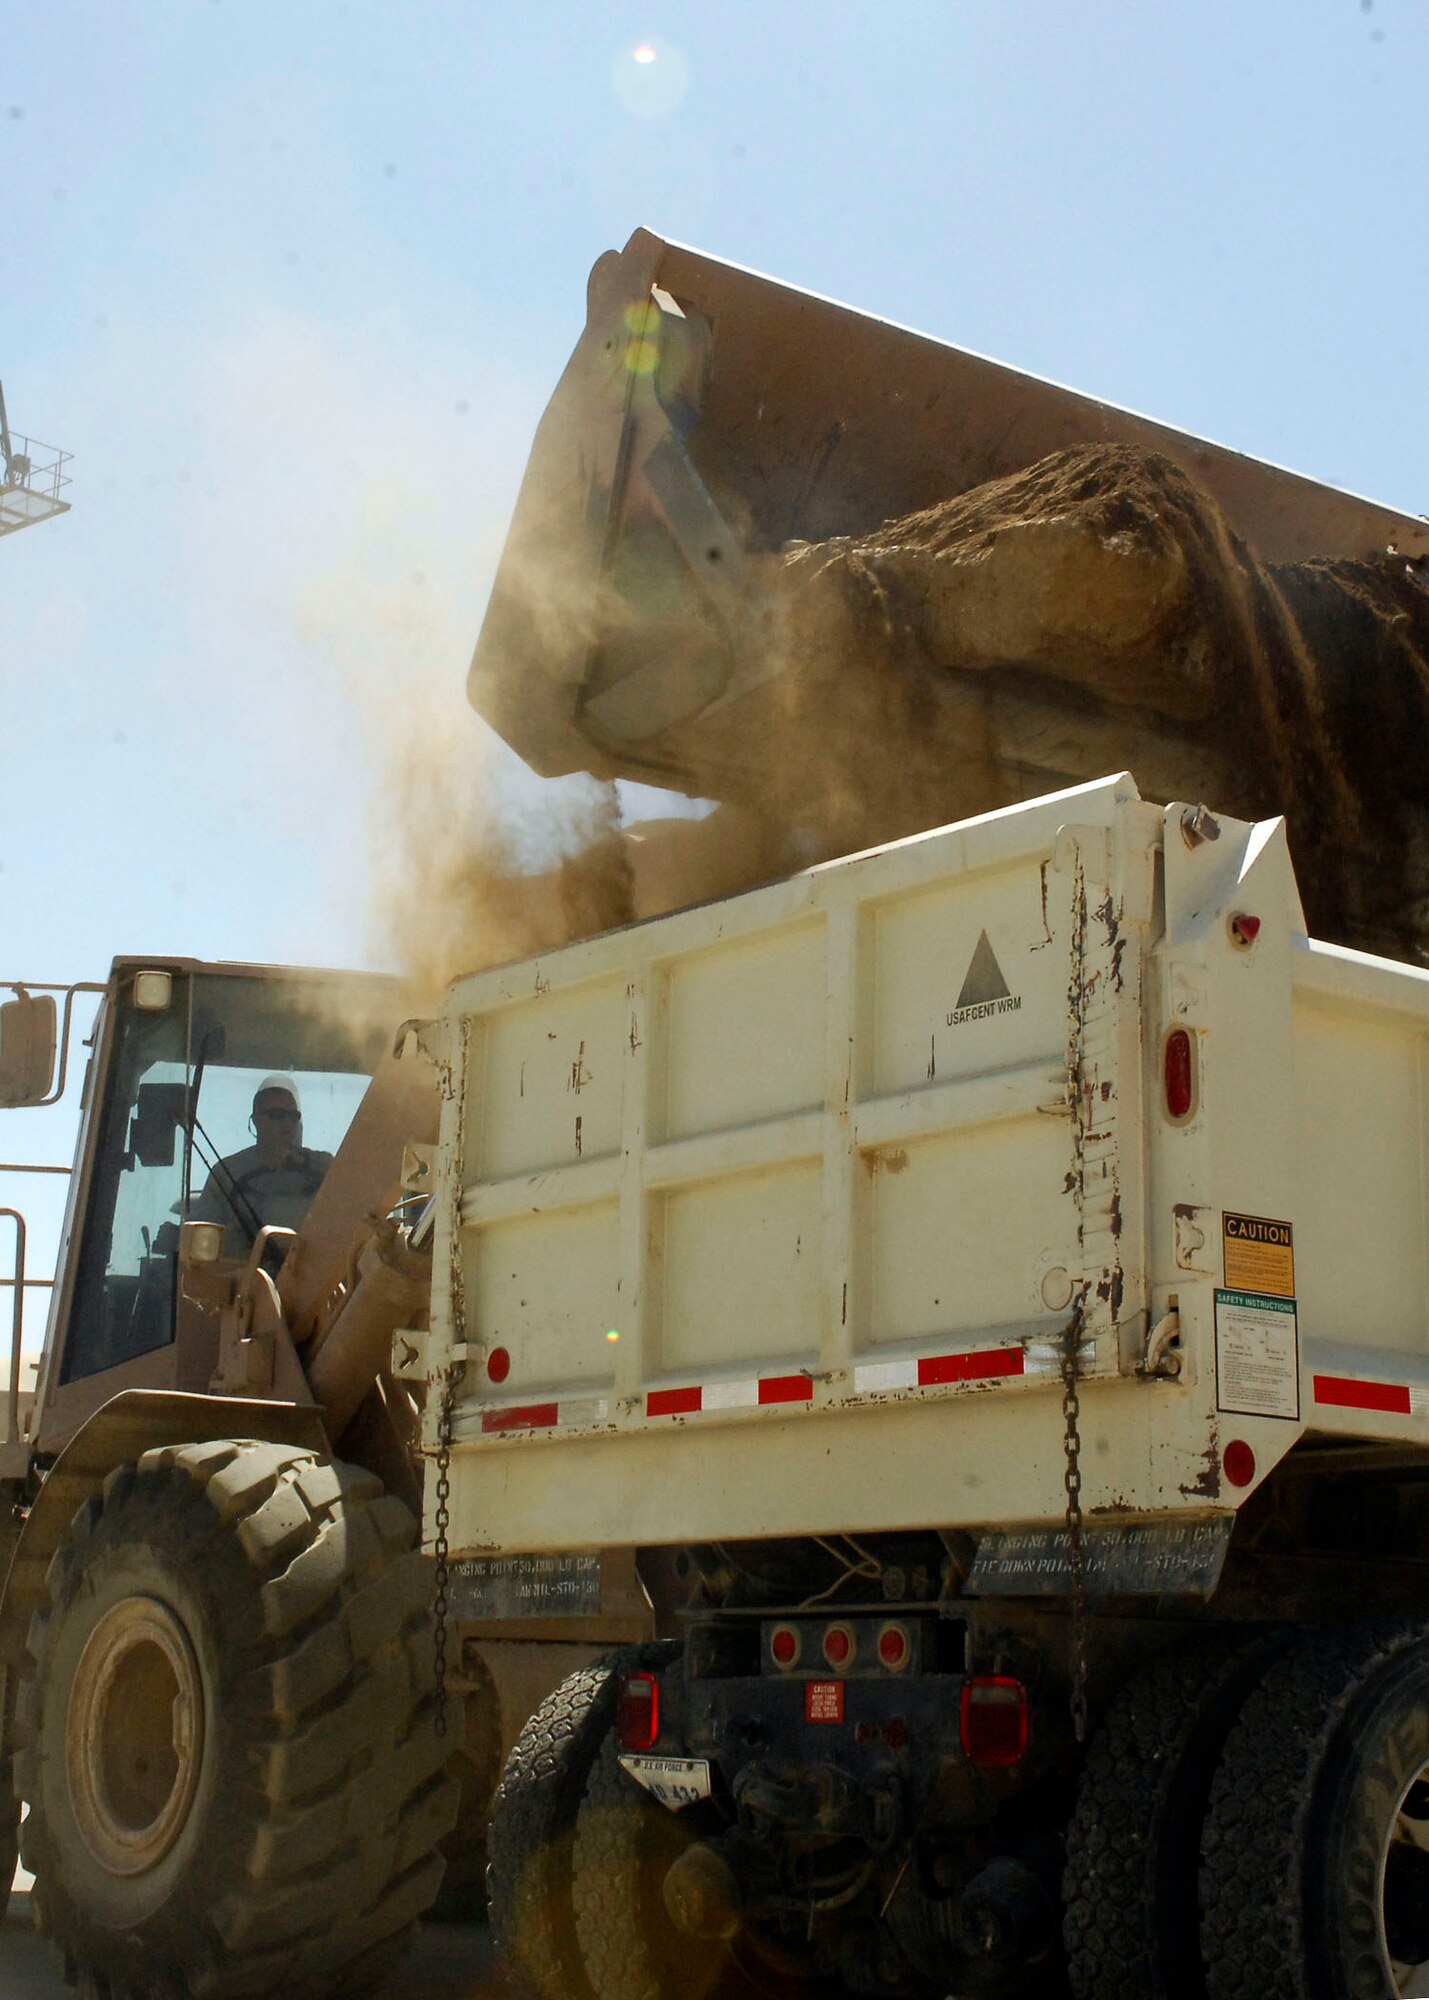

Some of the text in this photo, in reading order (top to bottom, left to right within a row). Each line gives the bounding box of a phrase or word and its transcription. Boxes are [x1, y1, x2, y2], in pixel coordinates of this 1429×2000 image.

[946, 996, 1021, 1026] USAFCENT WRM
[1227, 1219, 1289, 1244] CAUTION
[1217, 1294, 1293, 1313] SAFETY INSTRUCTIONS
[972, 1559, 998, 1574] TIE
[1037, 1557, 1083, 1574] POIN
